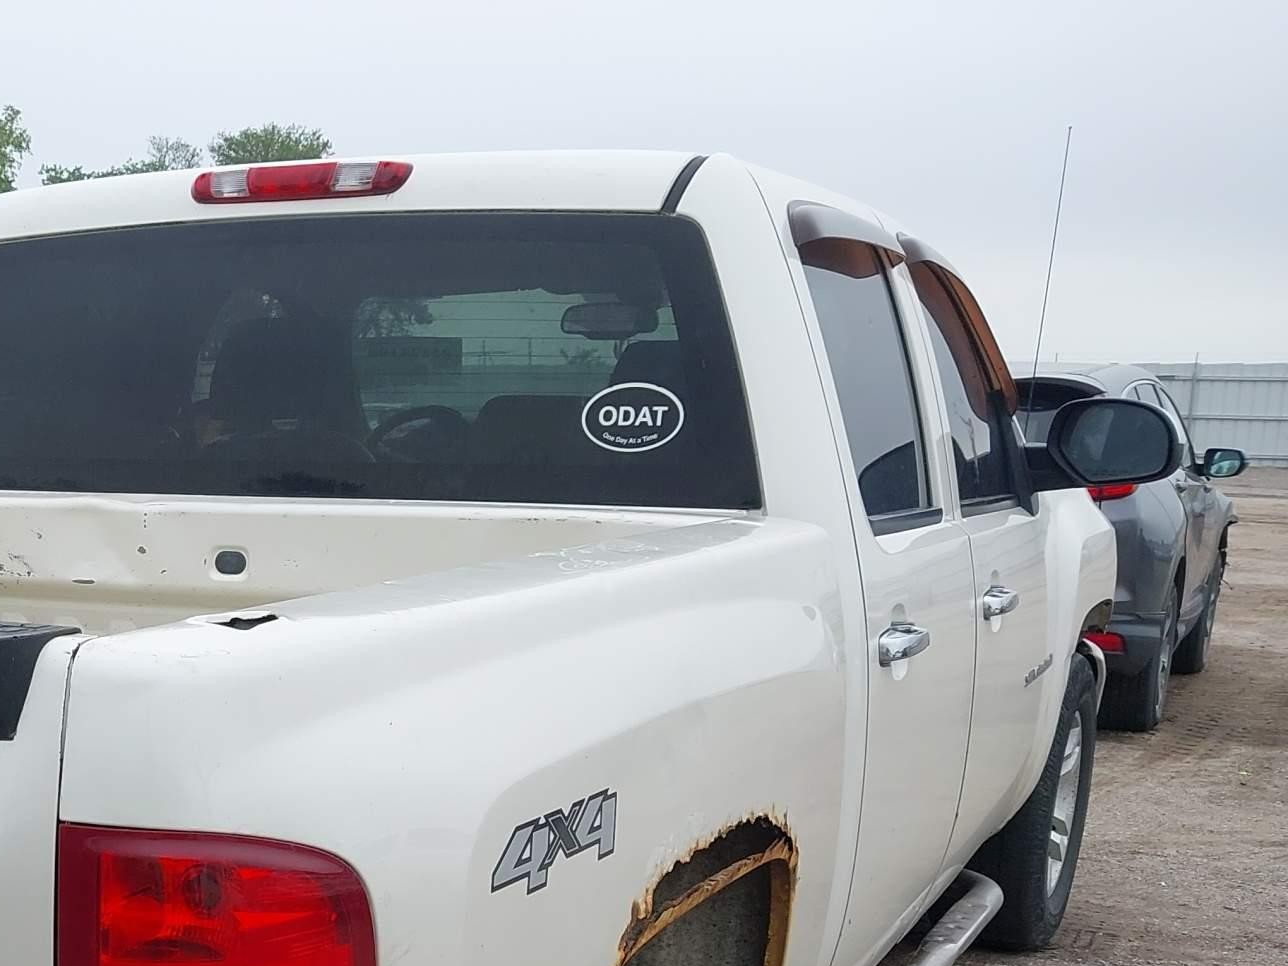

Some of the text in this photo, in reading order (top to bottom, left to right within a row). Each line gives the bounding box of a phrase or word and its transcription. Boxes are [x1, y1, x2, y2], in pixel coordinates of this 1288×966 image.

[598, 405, 669, 427] ODAT
[602, 431, 615, 442] One
[615, 436, 628, 445] Day
[642, 433, 658, 442] Time
